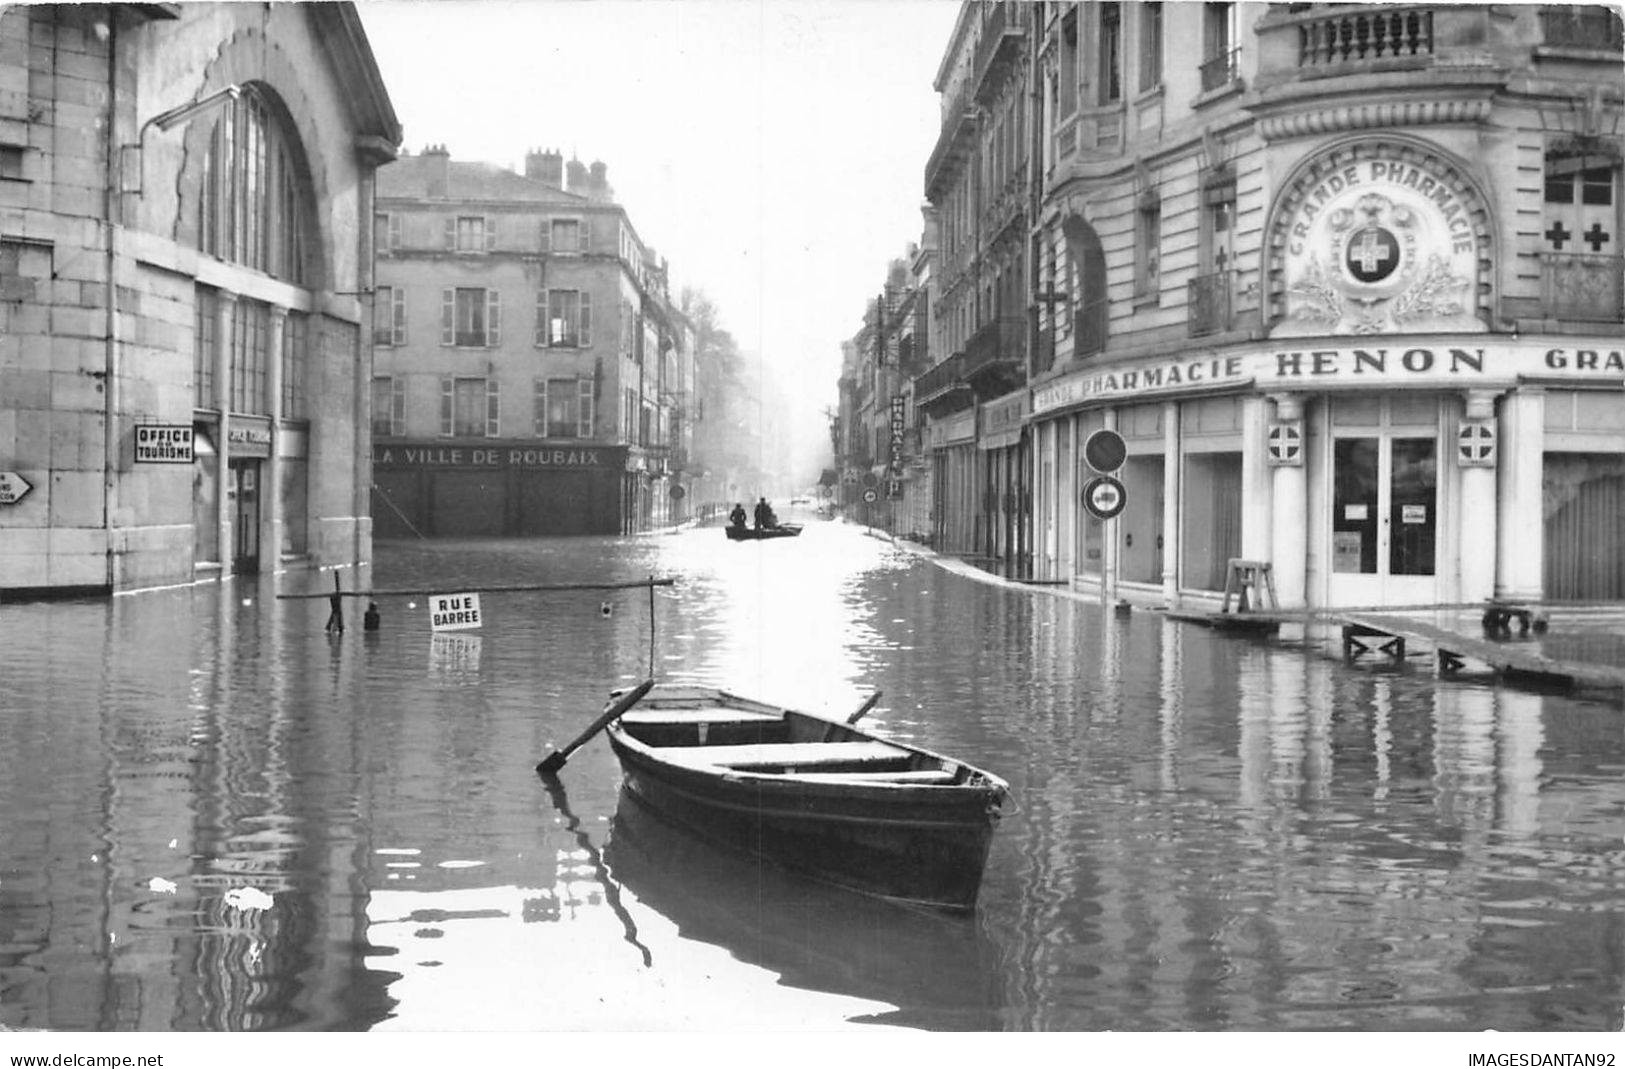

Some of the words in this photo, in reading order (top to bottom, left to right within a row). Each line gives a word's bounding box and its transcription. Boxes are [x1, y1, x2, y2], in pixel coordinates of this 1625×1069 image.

[1290, 166, 1360, 256] GRANDE
[1371, 161, 1473, 254] PHARMACIE
[1276, 350, 1485, 376] HENON
[1082, 356, 1243, 396] PHARMACIE
[140, 430, 190, 441] OFFICE
[139, 447, 190, 459] TOURISME
[405, 450, 462, 464] VILLE
[472, 450, 500, 464] DE
[510, 450, 598, 465] ROUBAIX
[439, 597, 472, 611] RUE
[434, 610, 478, 626] BARREE
